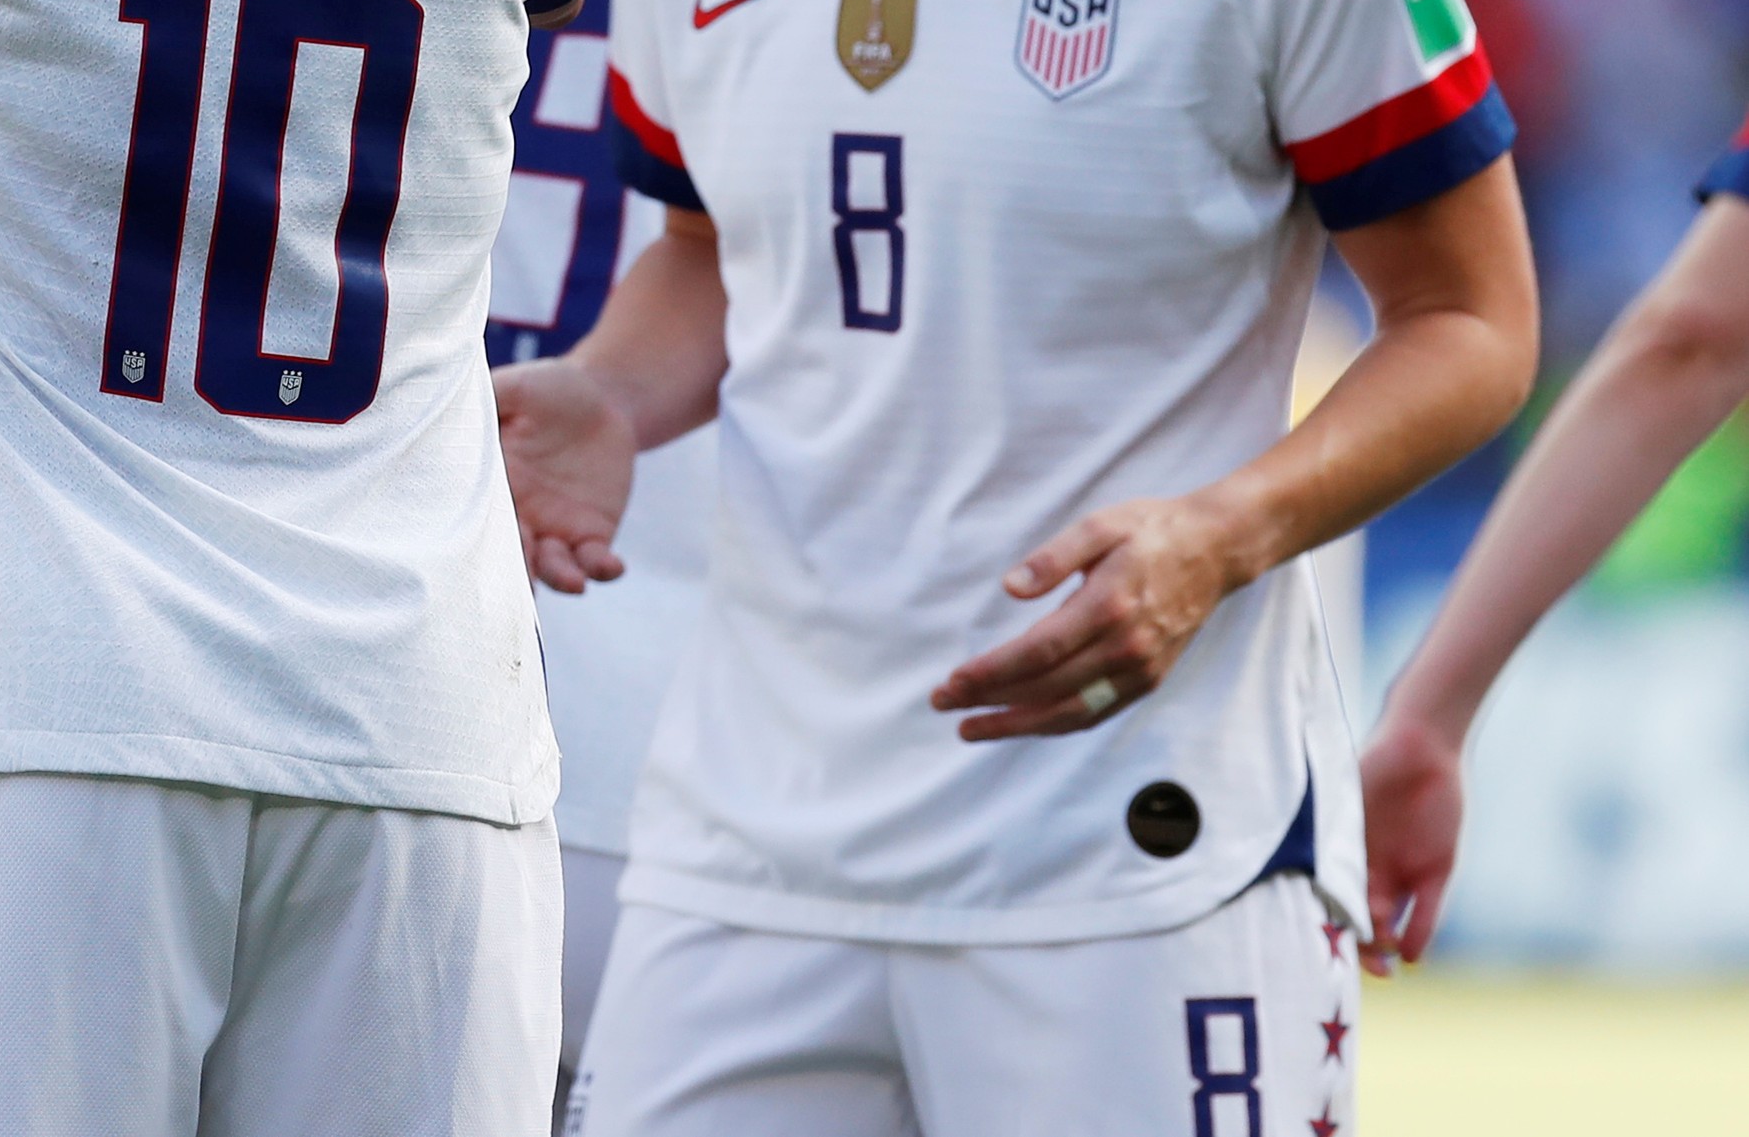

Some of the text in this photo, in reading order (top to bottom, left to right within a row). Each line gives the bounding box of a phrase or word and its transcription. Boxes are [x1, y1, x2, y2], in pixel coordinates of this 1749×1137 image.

[833, 131, 904, 334] 8
[124, 356, 144, 369] USA
[282, 376, 300, 389] USA
[1185, 996, 1261, 1137] 8
